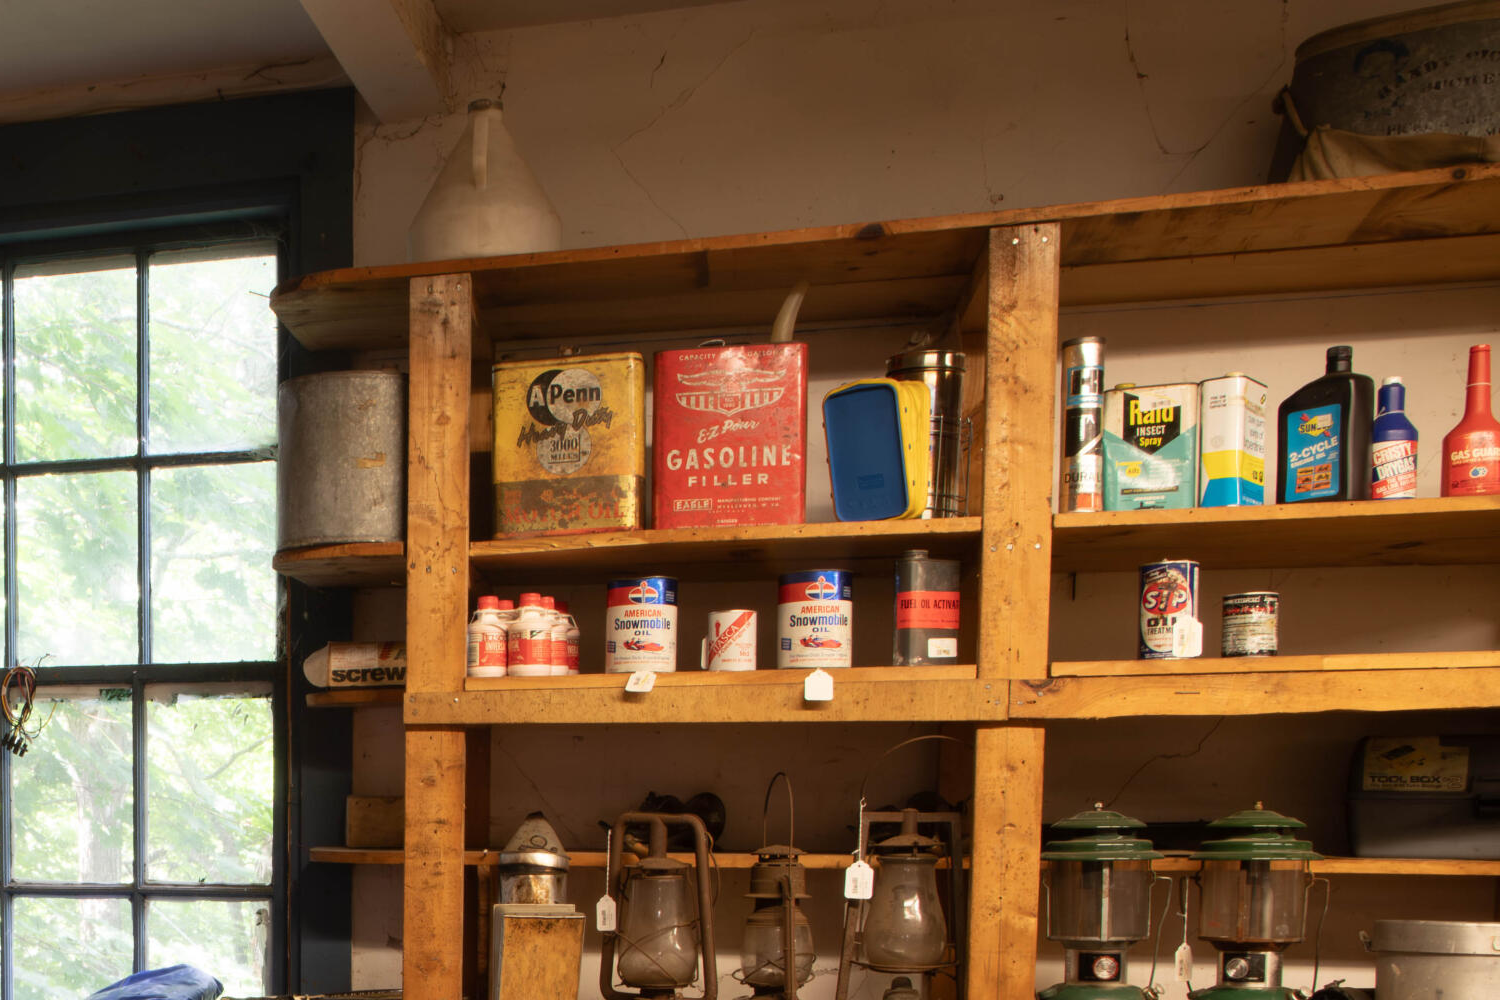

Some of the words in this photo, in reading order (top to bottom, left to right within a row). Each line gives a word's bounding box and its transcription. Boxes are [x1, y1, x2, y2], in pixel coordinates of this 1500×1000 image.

[529, 384, 545, 408] A
[550, 384, 600, 405] Penn
[572, 407, 613, 432] Duty
[722, 419, 760, 433] Pour
[1136, 425, 1166, 436] INSECT
[1300, 424, 1332, 433] SUN
[550, 437, 578, 451] 3000
[1139, 436, 1162, 448] Spray
[1290, 436, 1338, 462] 2-CYCLE
[1451, 450, 1470, 461] GAS
[667, 444, 792, 471] GASOLINE
[1376, 456, 1415, 480] DRYGAS
[688, 473, 769, 488] FILLER
[588, 499, 624, 519] OIL
[676, 500, 709, 510] EAGLE
[900, 599, 917, 609] FUEL
[920, 599, 931, 608] OIL
[1145, 590, 1187, 611] STP
[624, 609, 662, 618] AMERICAN
[801, 605, 840, 614] AMERICAN
[614, 618, 671, 631] Snowmobile
[789, 614, 848, 627] Snowmobile
[1369, 775, 1407, 783] TOOL
[1410, 775, 1441, 783] BOX
